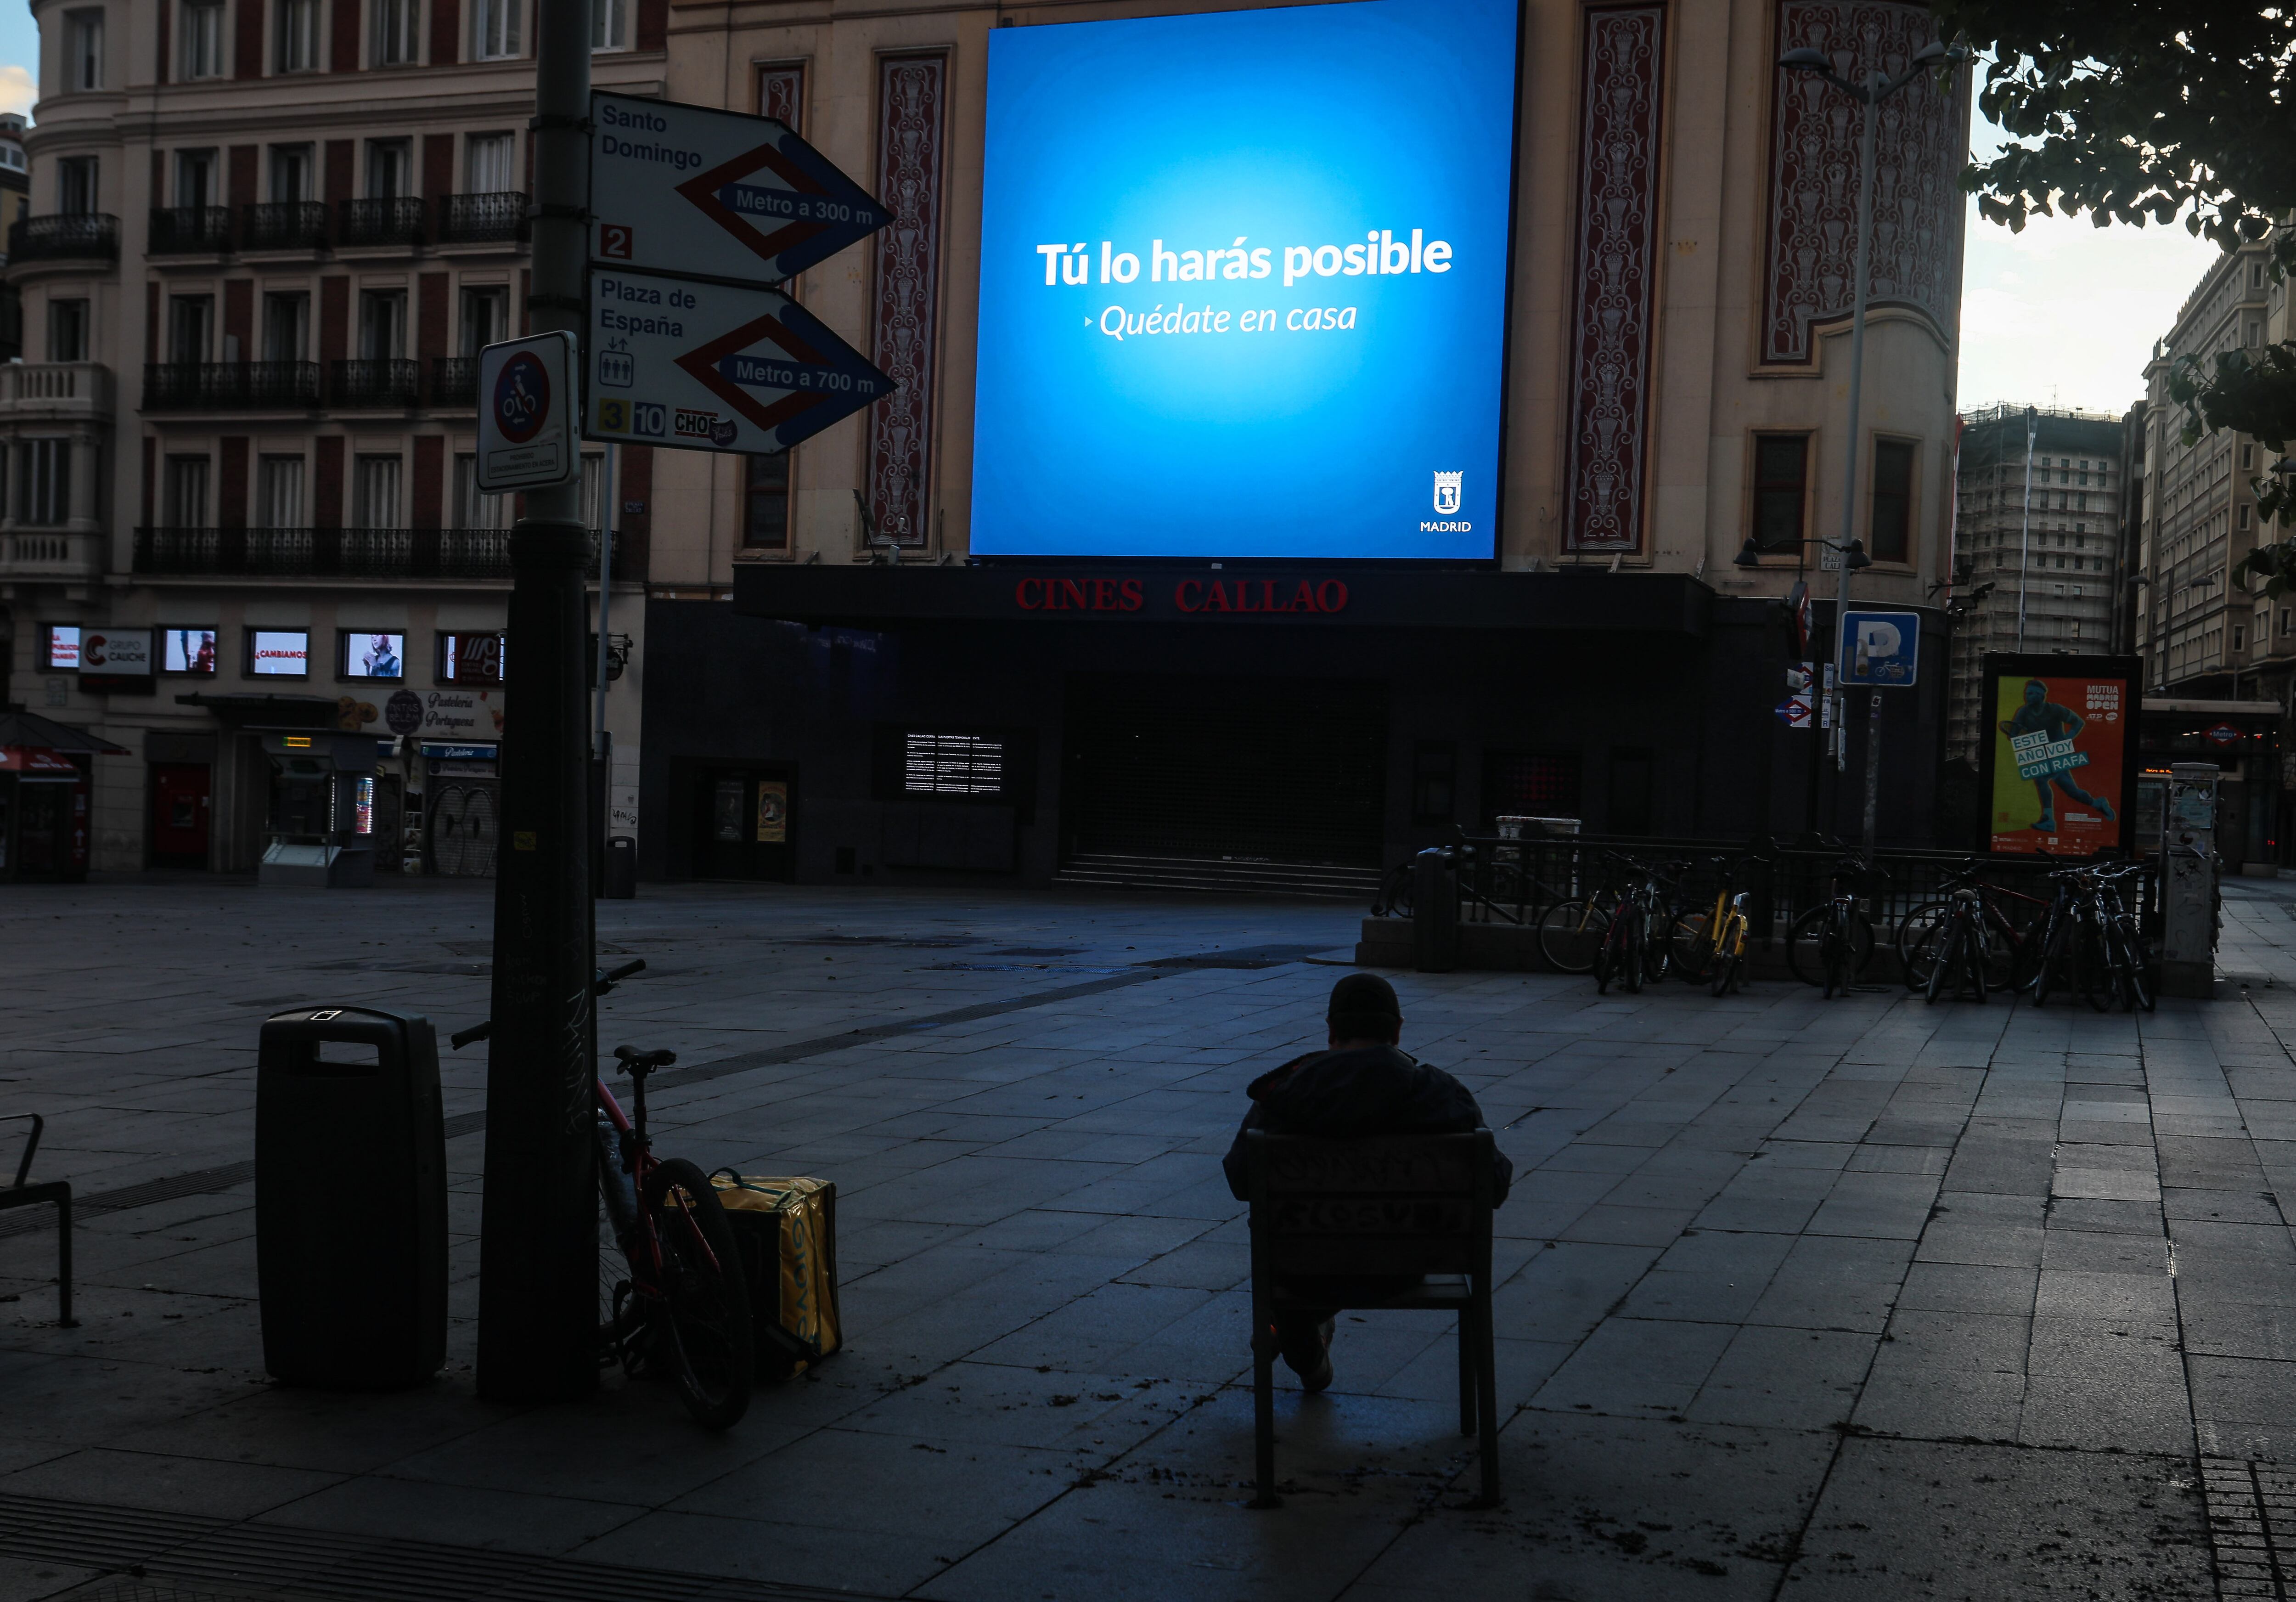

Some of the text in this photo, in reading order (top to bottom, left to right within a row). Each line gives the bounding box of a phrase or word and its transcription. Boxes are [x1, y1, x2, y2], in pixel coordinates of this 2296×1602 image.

[603, 105, 666, 132] Santo
[602, 135, 702, 170] Domingo
[737, 190, 872, 224] Metro a 300 m
[607, 229, 626, 256] 2
[1037, 229, 1452, 287] Tú lo harás posible
[602, 279, 696, 309] Plaza de
[601, 308, 682, 337] España
[1101, 303, 1357, 340] Quédate en casa
[737, 361, 874, 393] Metro a 700 m
[604, 402, 665, 434] 3 10
[491, 461, 531, 473] ESTACIONAMIENTO
[1420, 522, 1472, 532] MADRID
[1016, 578, 1348, 613] CINES CALLAO
[109, 641, 141, 650] GRUPO
[1855, 621, 1902, 676] P
[428, 692, 473, 708] Pastelería
[2087, 685, 2118, 694] MUTUA
[426, 711, 474, 729] Portuguesa
[2013, 732, 2046, 749] ESTE
[2018, 741, 2071, 764] AÑO VOY
[2022, 754, 2088, 778] CON RAFA
